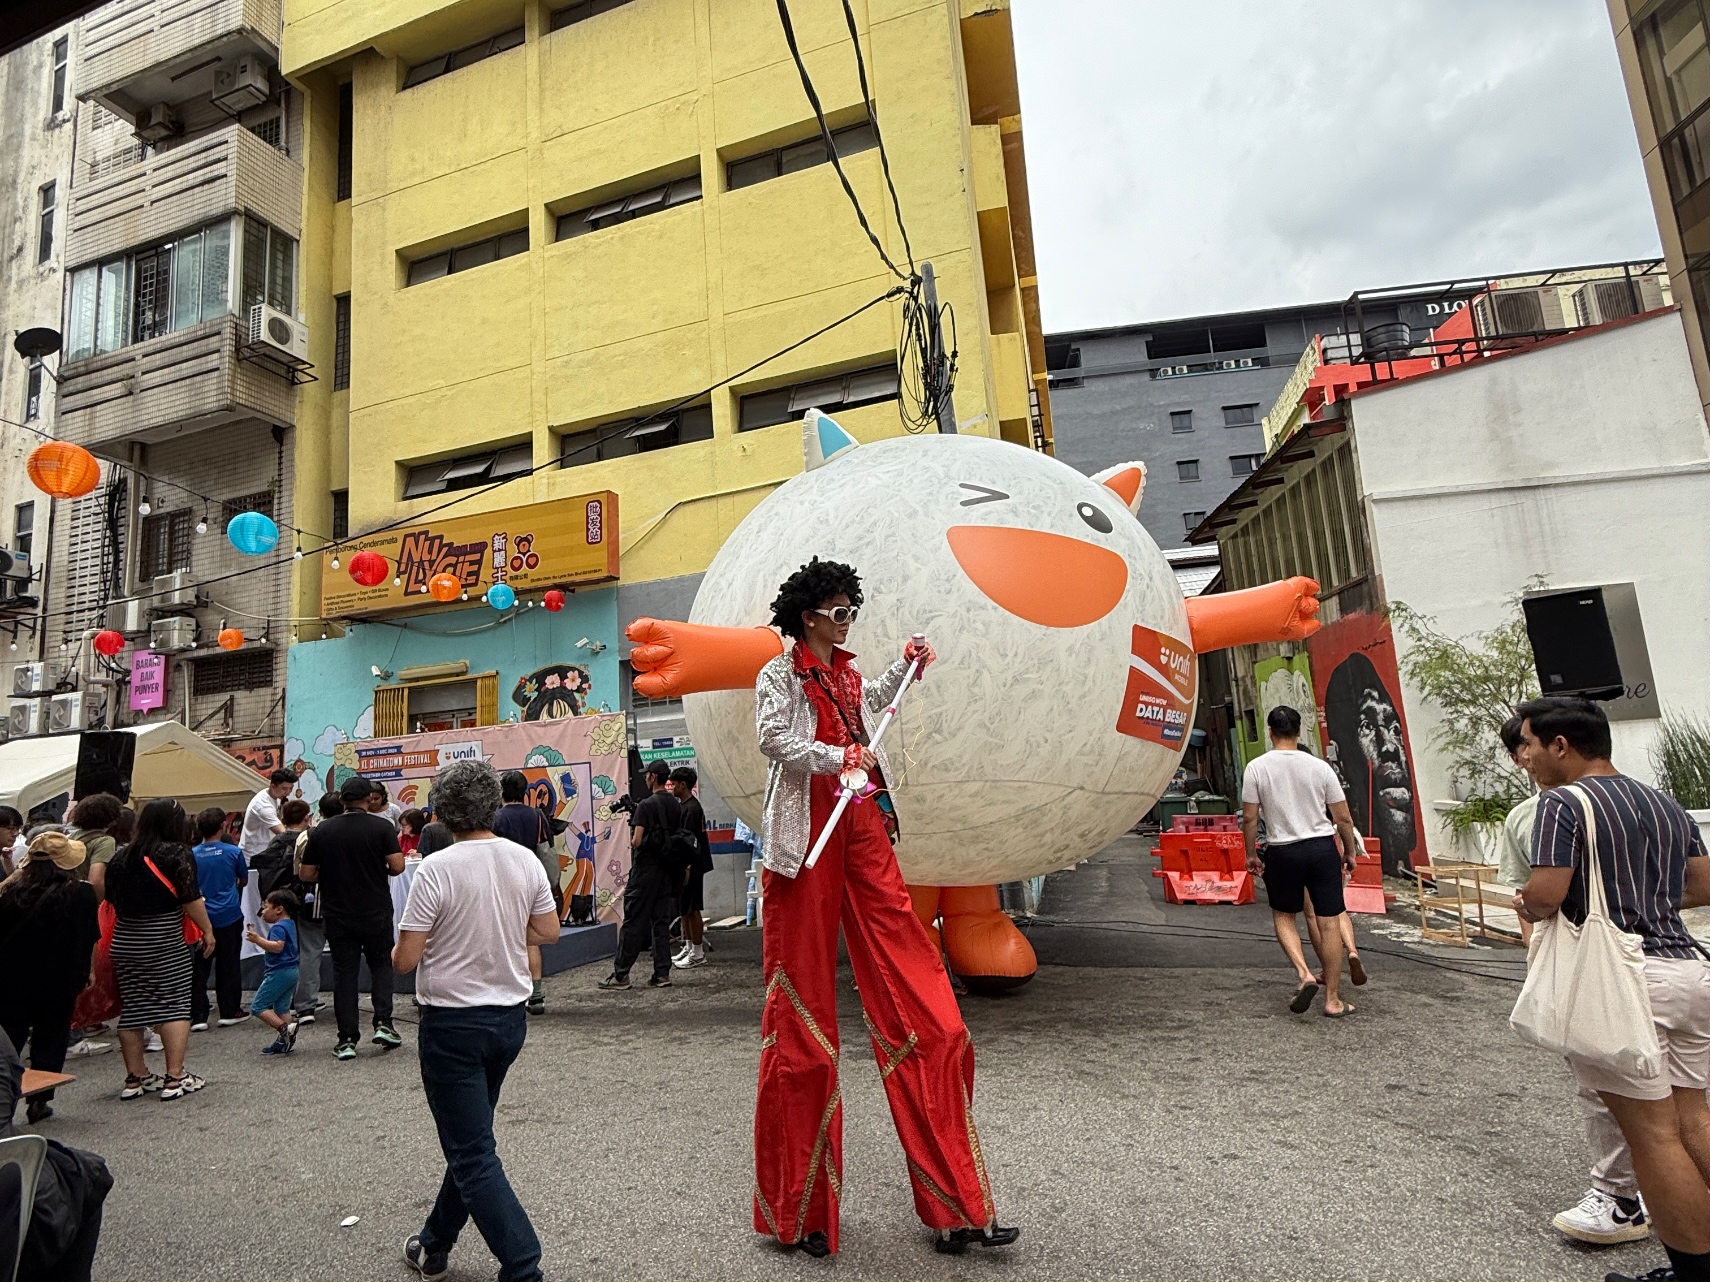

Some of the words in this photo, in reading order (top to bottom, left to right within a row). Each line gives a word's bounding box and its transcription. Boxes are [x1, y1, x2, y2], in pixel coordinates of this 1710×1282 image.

[588, 501, 601, 542] 批发站
[140, 670, 155, 681] BAIK
[135, 683, 160, 696] PUNYER
[1135, 703, 1163, 721] DATA
[453, 747, 476, 760] unifi
[654, 750, 694, 760] KESELAMATAN
[369, 756, 402, 769] CHINATOWN
[404, 754, 431, 766] FESTIVAL
